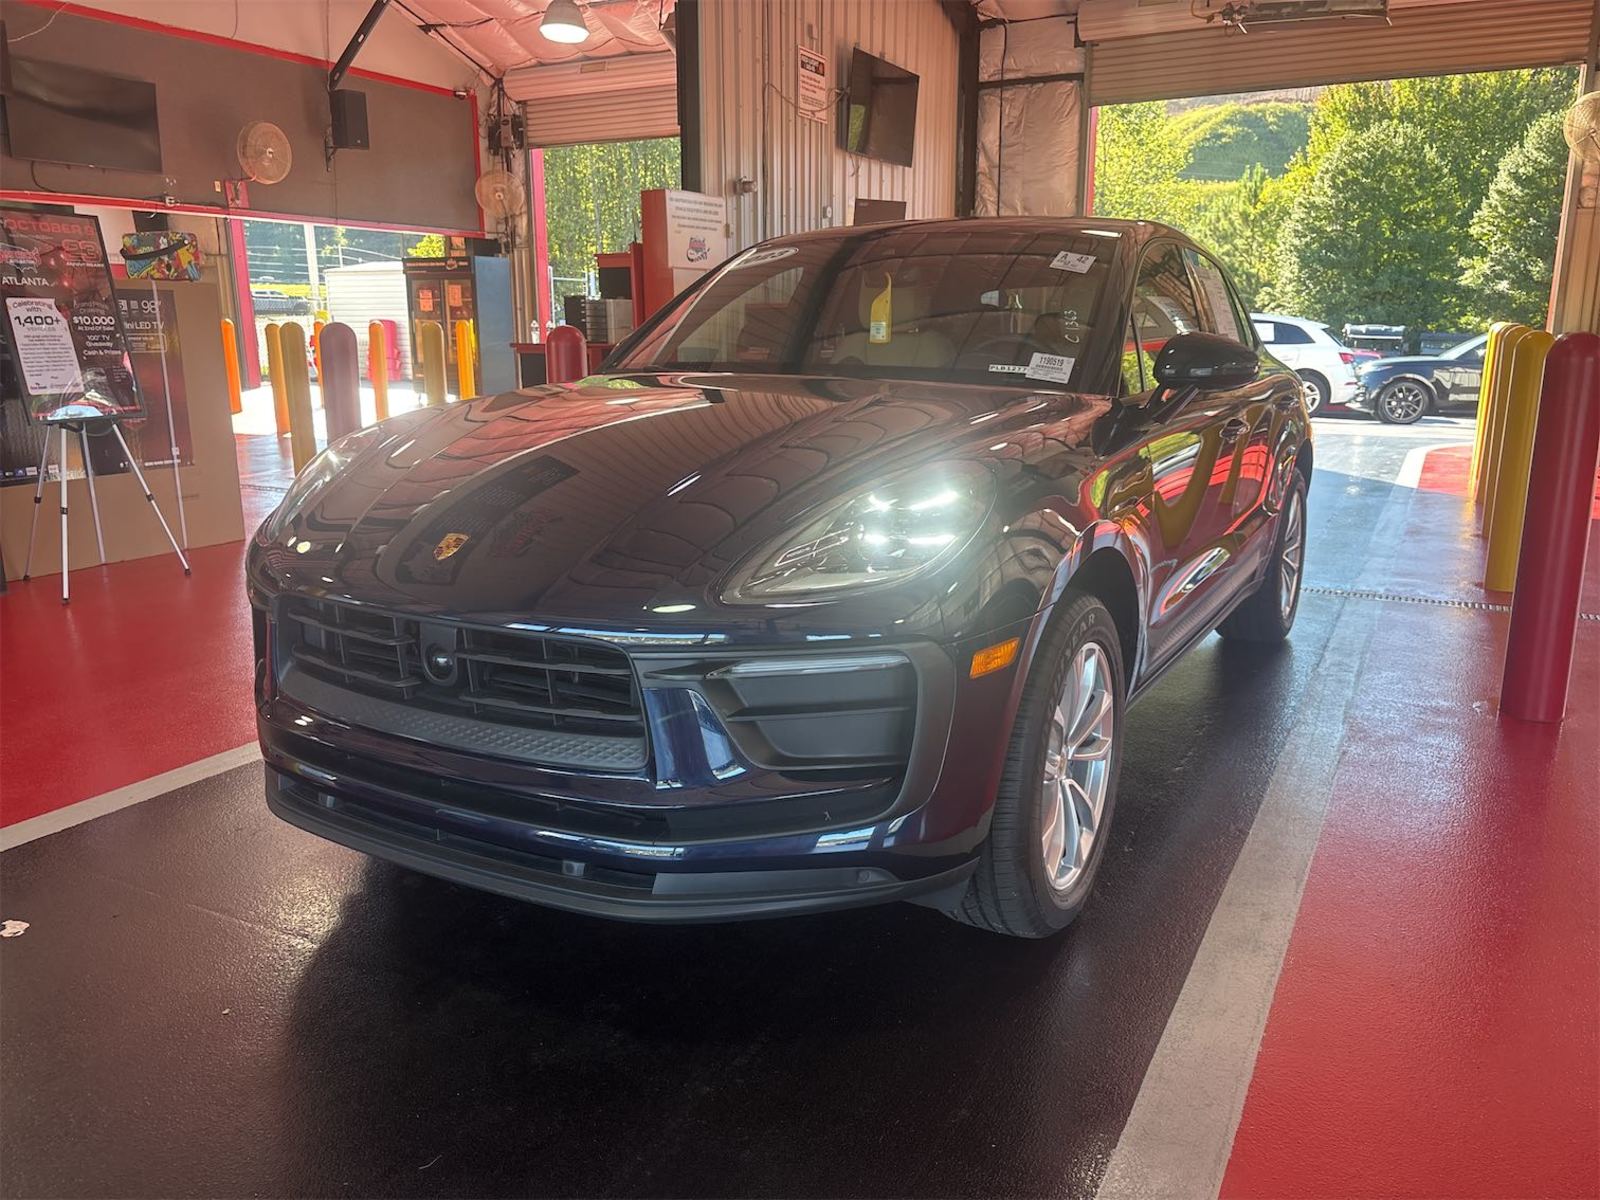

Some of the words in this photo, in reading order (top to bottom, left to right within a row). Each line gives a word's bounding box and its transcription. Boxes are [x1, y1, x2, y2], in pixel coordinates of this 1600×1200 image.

[4, 219, 82, 233] OCTOBER
[2, 276, 50, 287] ATLANTA
[14, 315, 61, 327] 1,400+
[135, 321, 151, 330] LED
